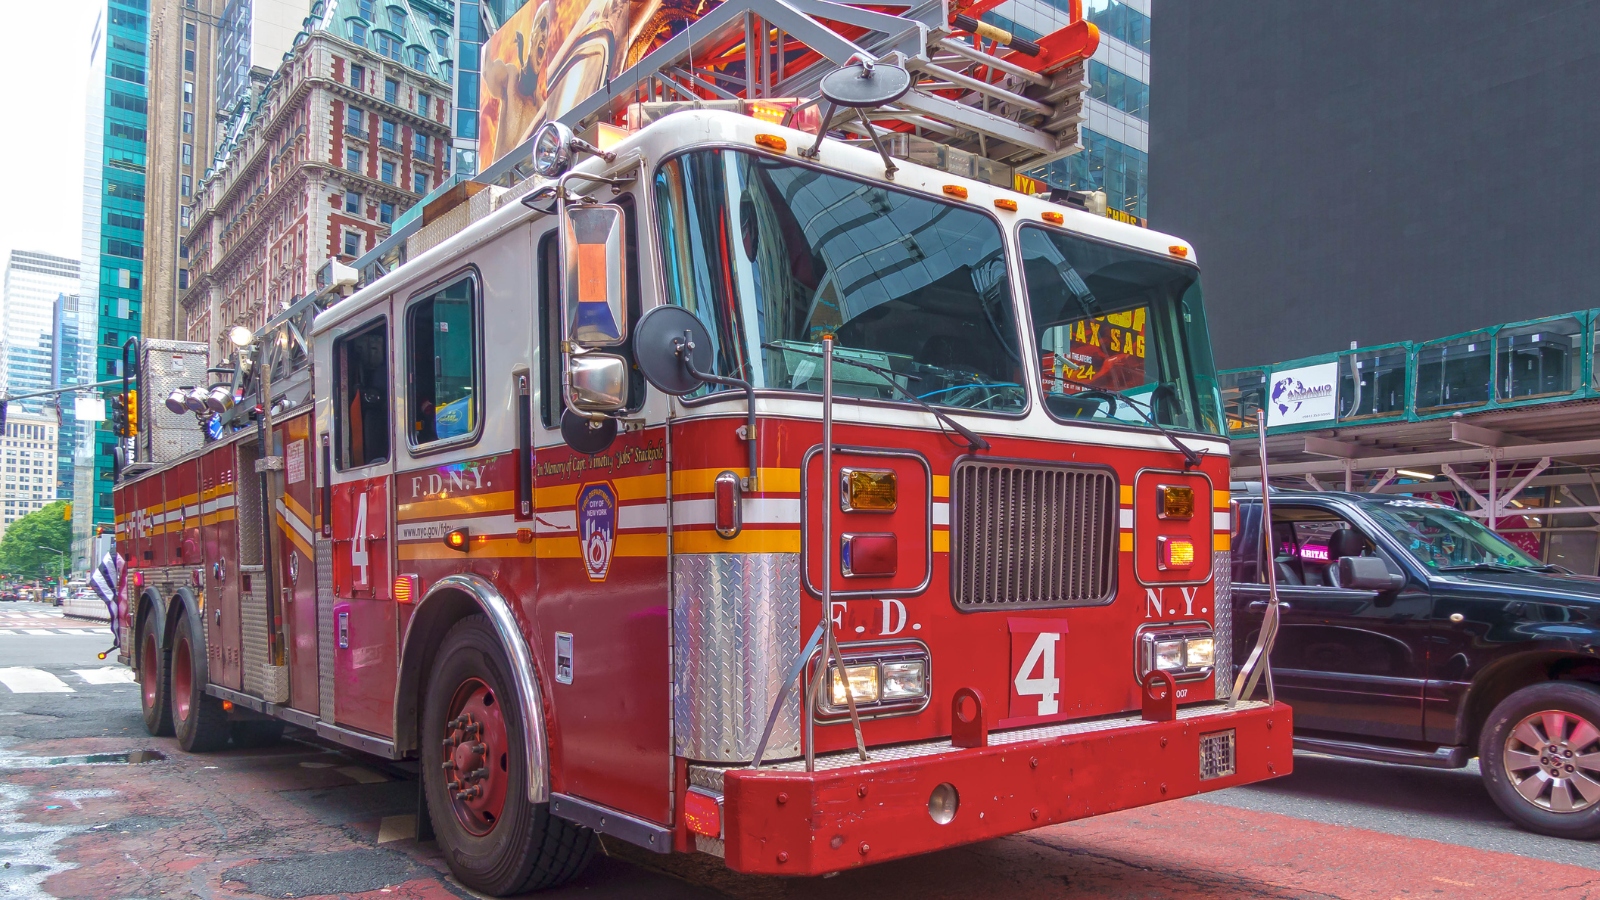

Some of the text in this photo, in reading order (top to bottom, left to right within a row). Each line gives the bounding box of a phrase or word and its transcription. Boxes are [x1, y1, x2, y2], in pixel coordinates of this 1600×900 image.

[1106, 206, 1137, 226] CHRIS
[1069, 320, 1100, 347] AX
[1076, 365, 1096, 381] 24
[1287, 384, 1332, 398] ANDAMIO
[544, 461, 566, 480] Memory
[566, 454, 573, 480] of
[411, 465, 492, 498] F.D.N.Y.
[586, 508, 608, 517] NEW YORK
[589, 500, 599, 508] CITY
[352, 493, 368, 585] 4
[1014, 632, 1061, 716] 4
